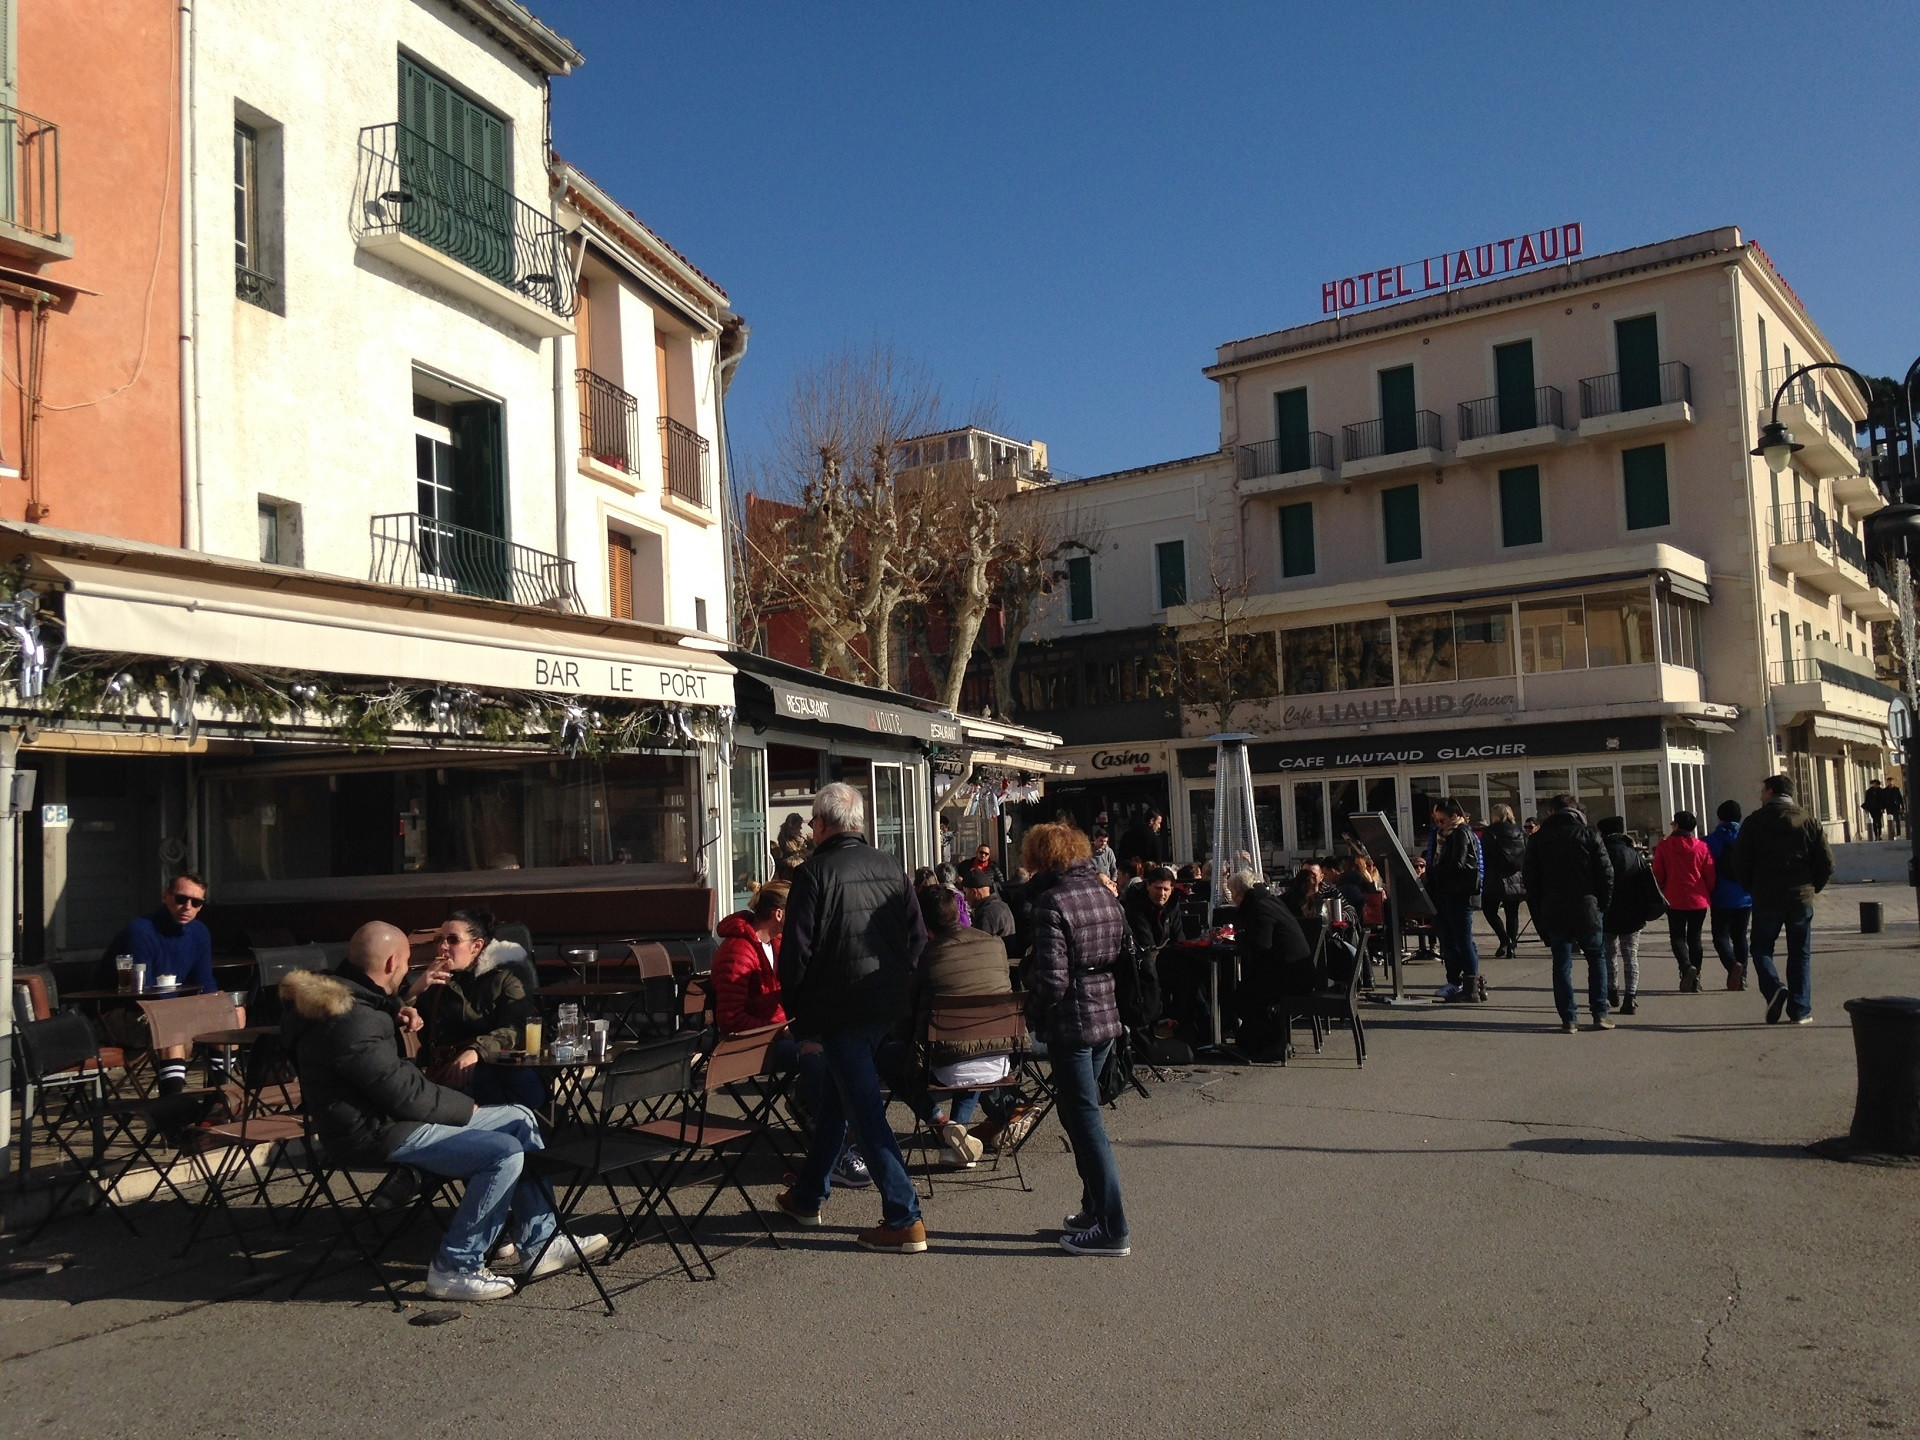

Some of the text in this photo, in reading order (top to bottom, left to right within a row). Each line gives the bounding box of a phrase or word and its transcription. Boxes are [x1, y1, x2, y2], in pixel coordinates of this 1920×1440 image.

[1322, 222, 1582, 313] HOTEL LIAUTAUD
[536, 658, 707, 699] BAR LE PORT
[786, 694, 831, 719] RESTAURANT
[1318, 694, 1454, 724] LIAUTAUD
[1091, 750, 1150, 770] Casino
[1279, 743, 1527, 768] CAFE LIAUTAUD GLACIER
[44, 806, 68, 822] CB
